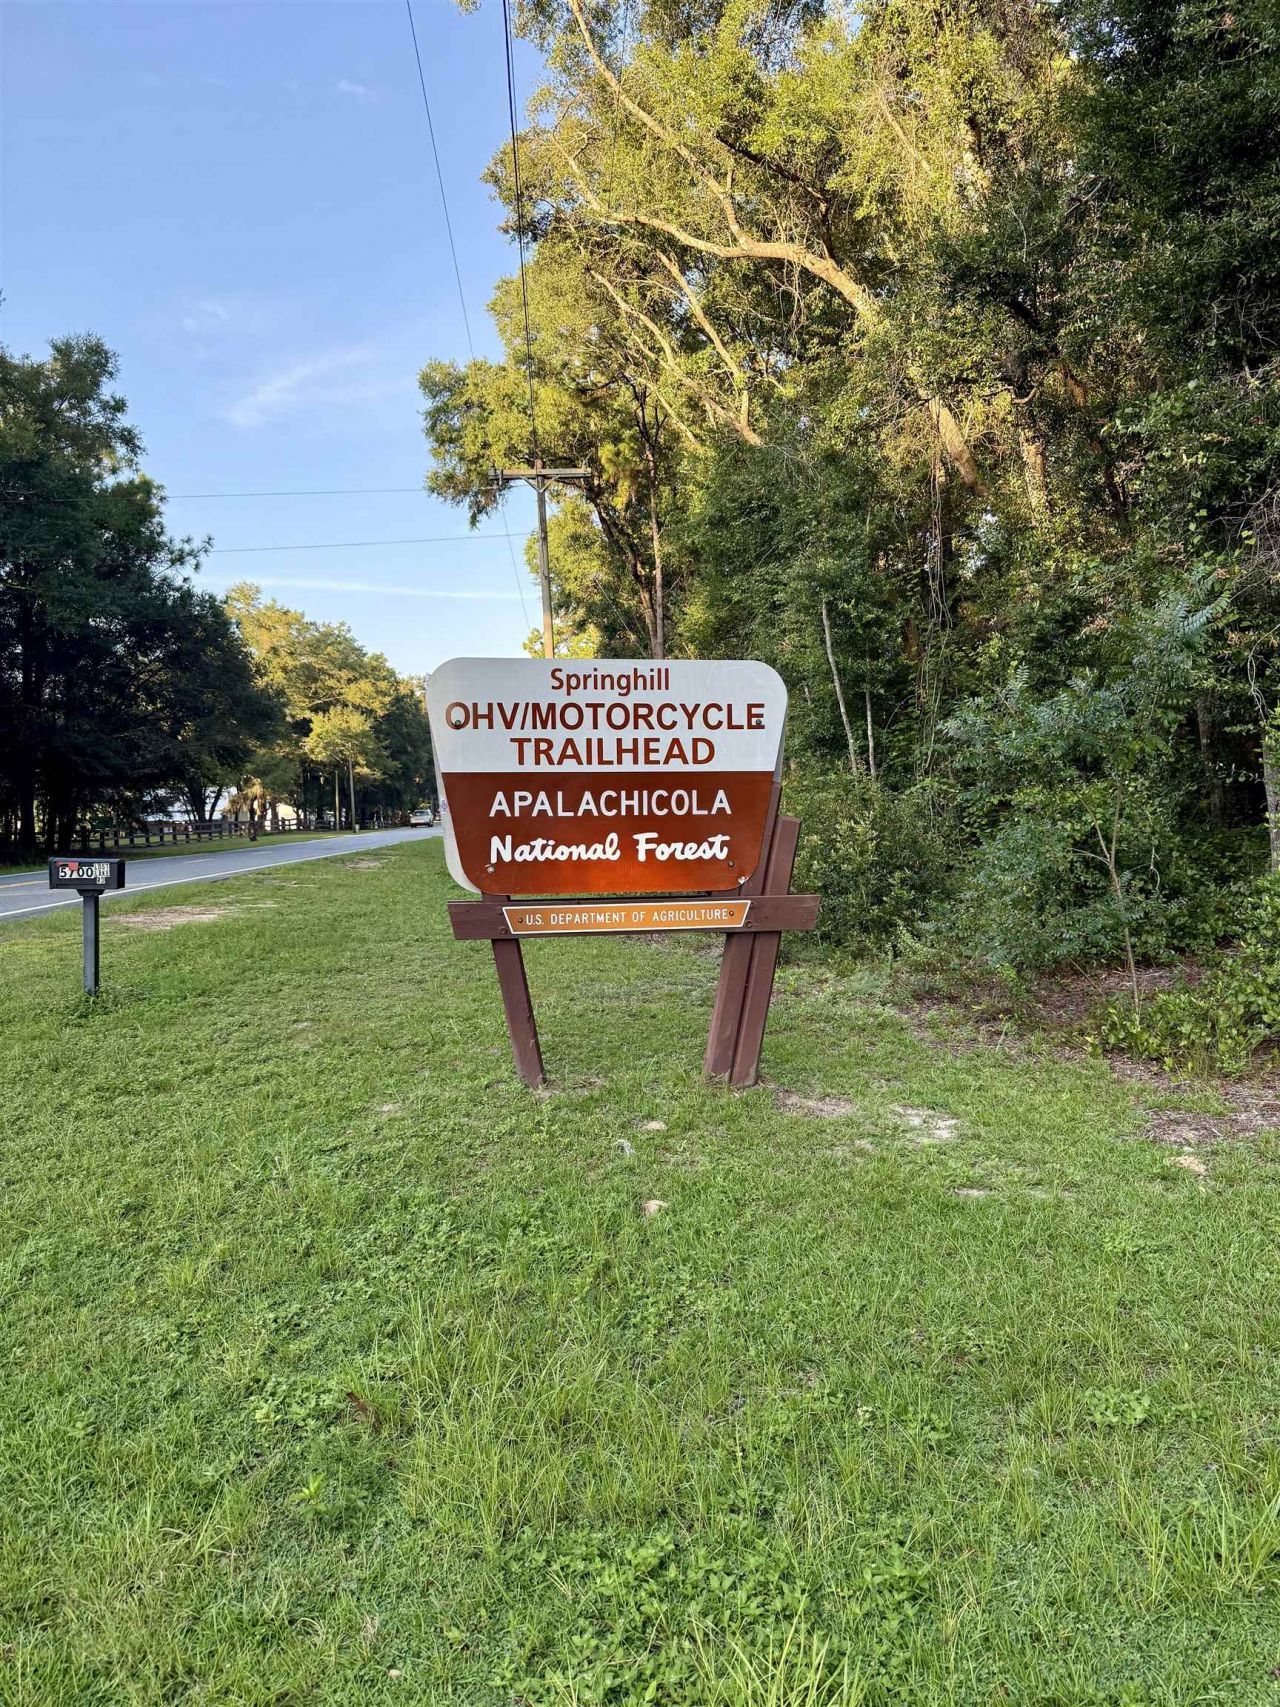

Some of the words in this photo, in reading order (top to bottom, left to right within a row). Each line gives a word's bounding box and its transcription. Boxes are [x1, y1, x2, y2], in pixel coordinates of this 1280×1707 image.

[550, 667, 670, 696] Springhill
[445, 702, 765, 731] OHV/MOTORCYCLE
[510, 737, 716, 766] TRAILHEAD
[489, 789, 732, 817] APALACHICOLA
[490, 832, 621, 864] National
[633, 832, 730, 862] Forest
[526, 914, 544, 926] U.S.
[551, 912, 626, 925] DEPARTMENT
[632, 911, 645, 923] OF
[653, 909, 729, 922] AGRICULTURE
